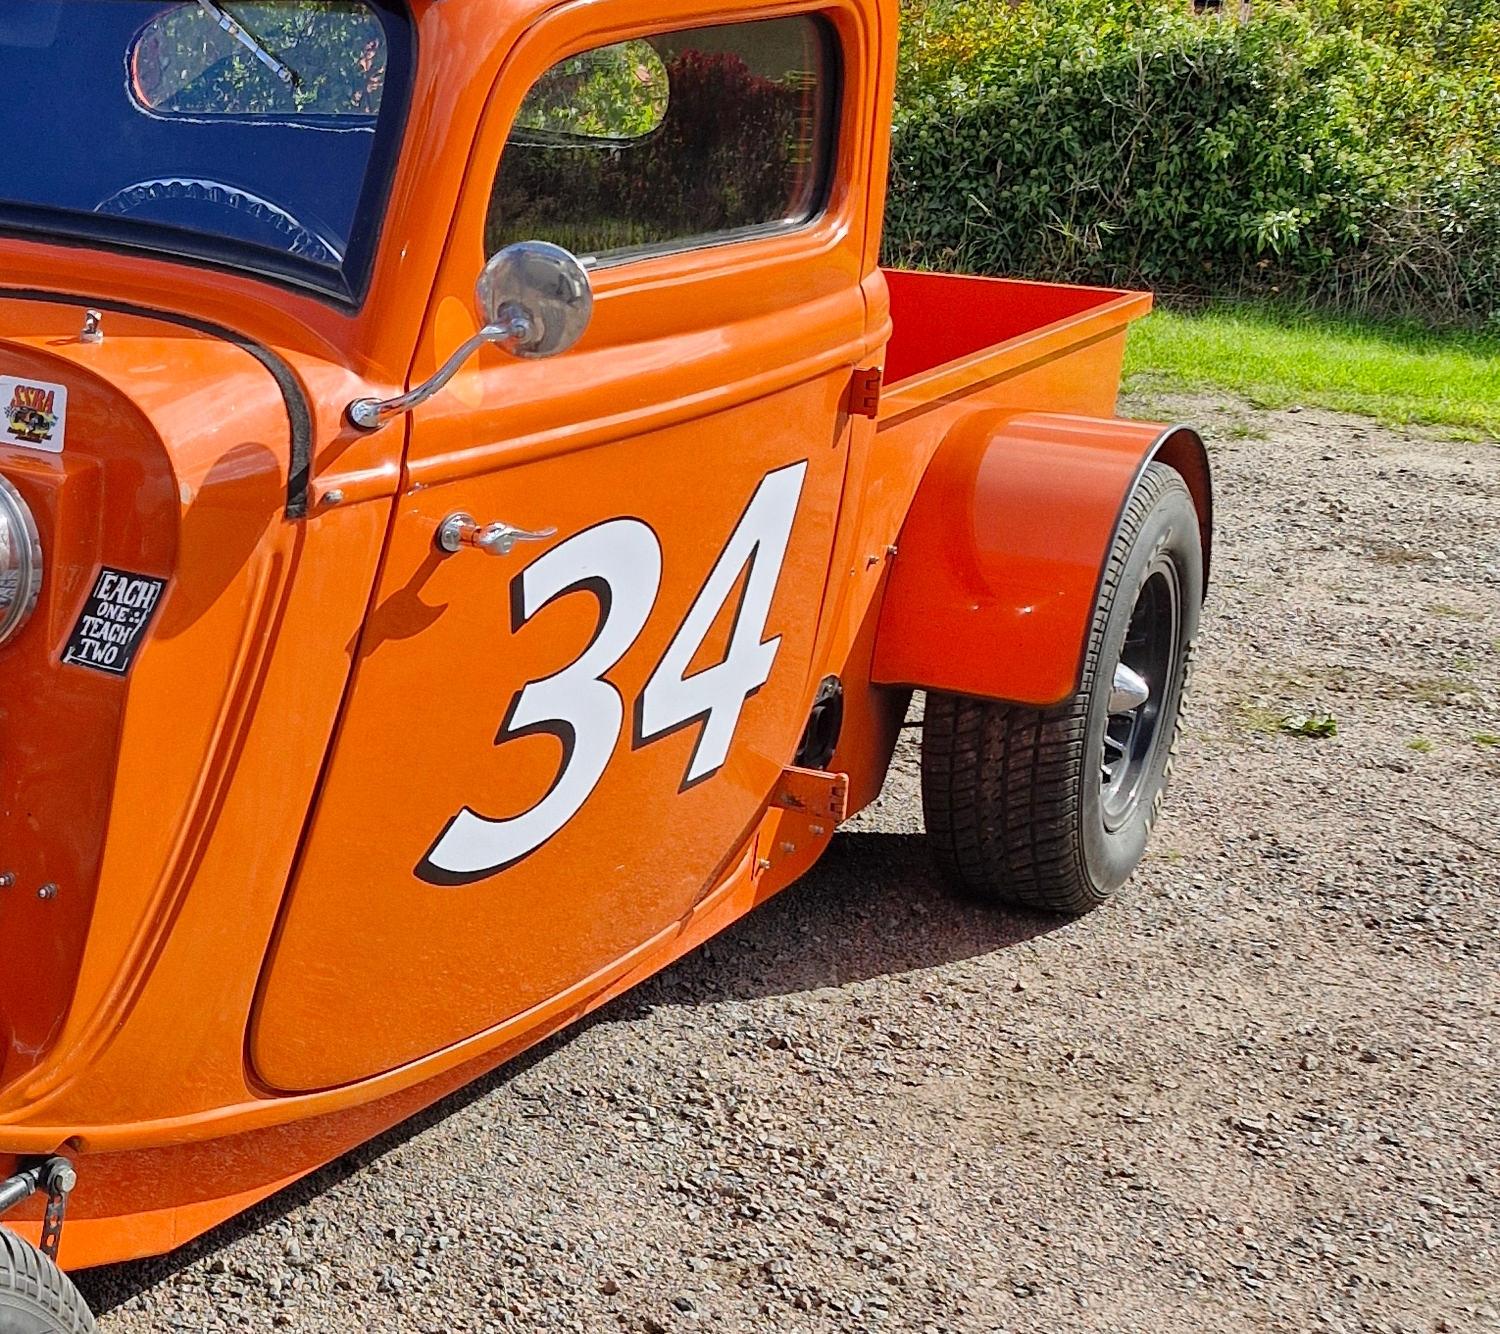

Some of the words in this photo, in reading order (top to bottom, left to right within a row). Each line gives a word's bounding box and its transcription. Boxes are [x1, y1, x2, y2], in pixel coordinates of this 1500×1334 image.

[97, 574, 156, 609] EACH
[97, 601, 130, 622] ONE
[80, 615, 133, 645] TEACH
[78, 638, 119, 665] TWO
[414, 460, 808, 886] 34
